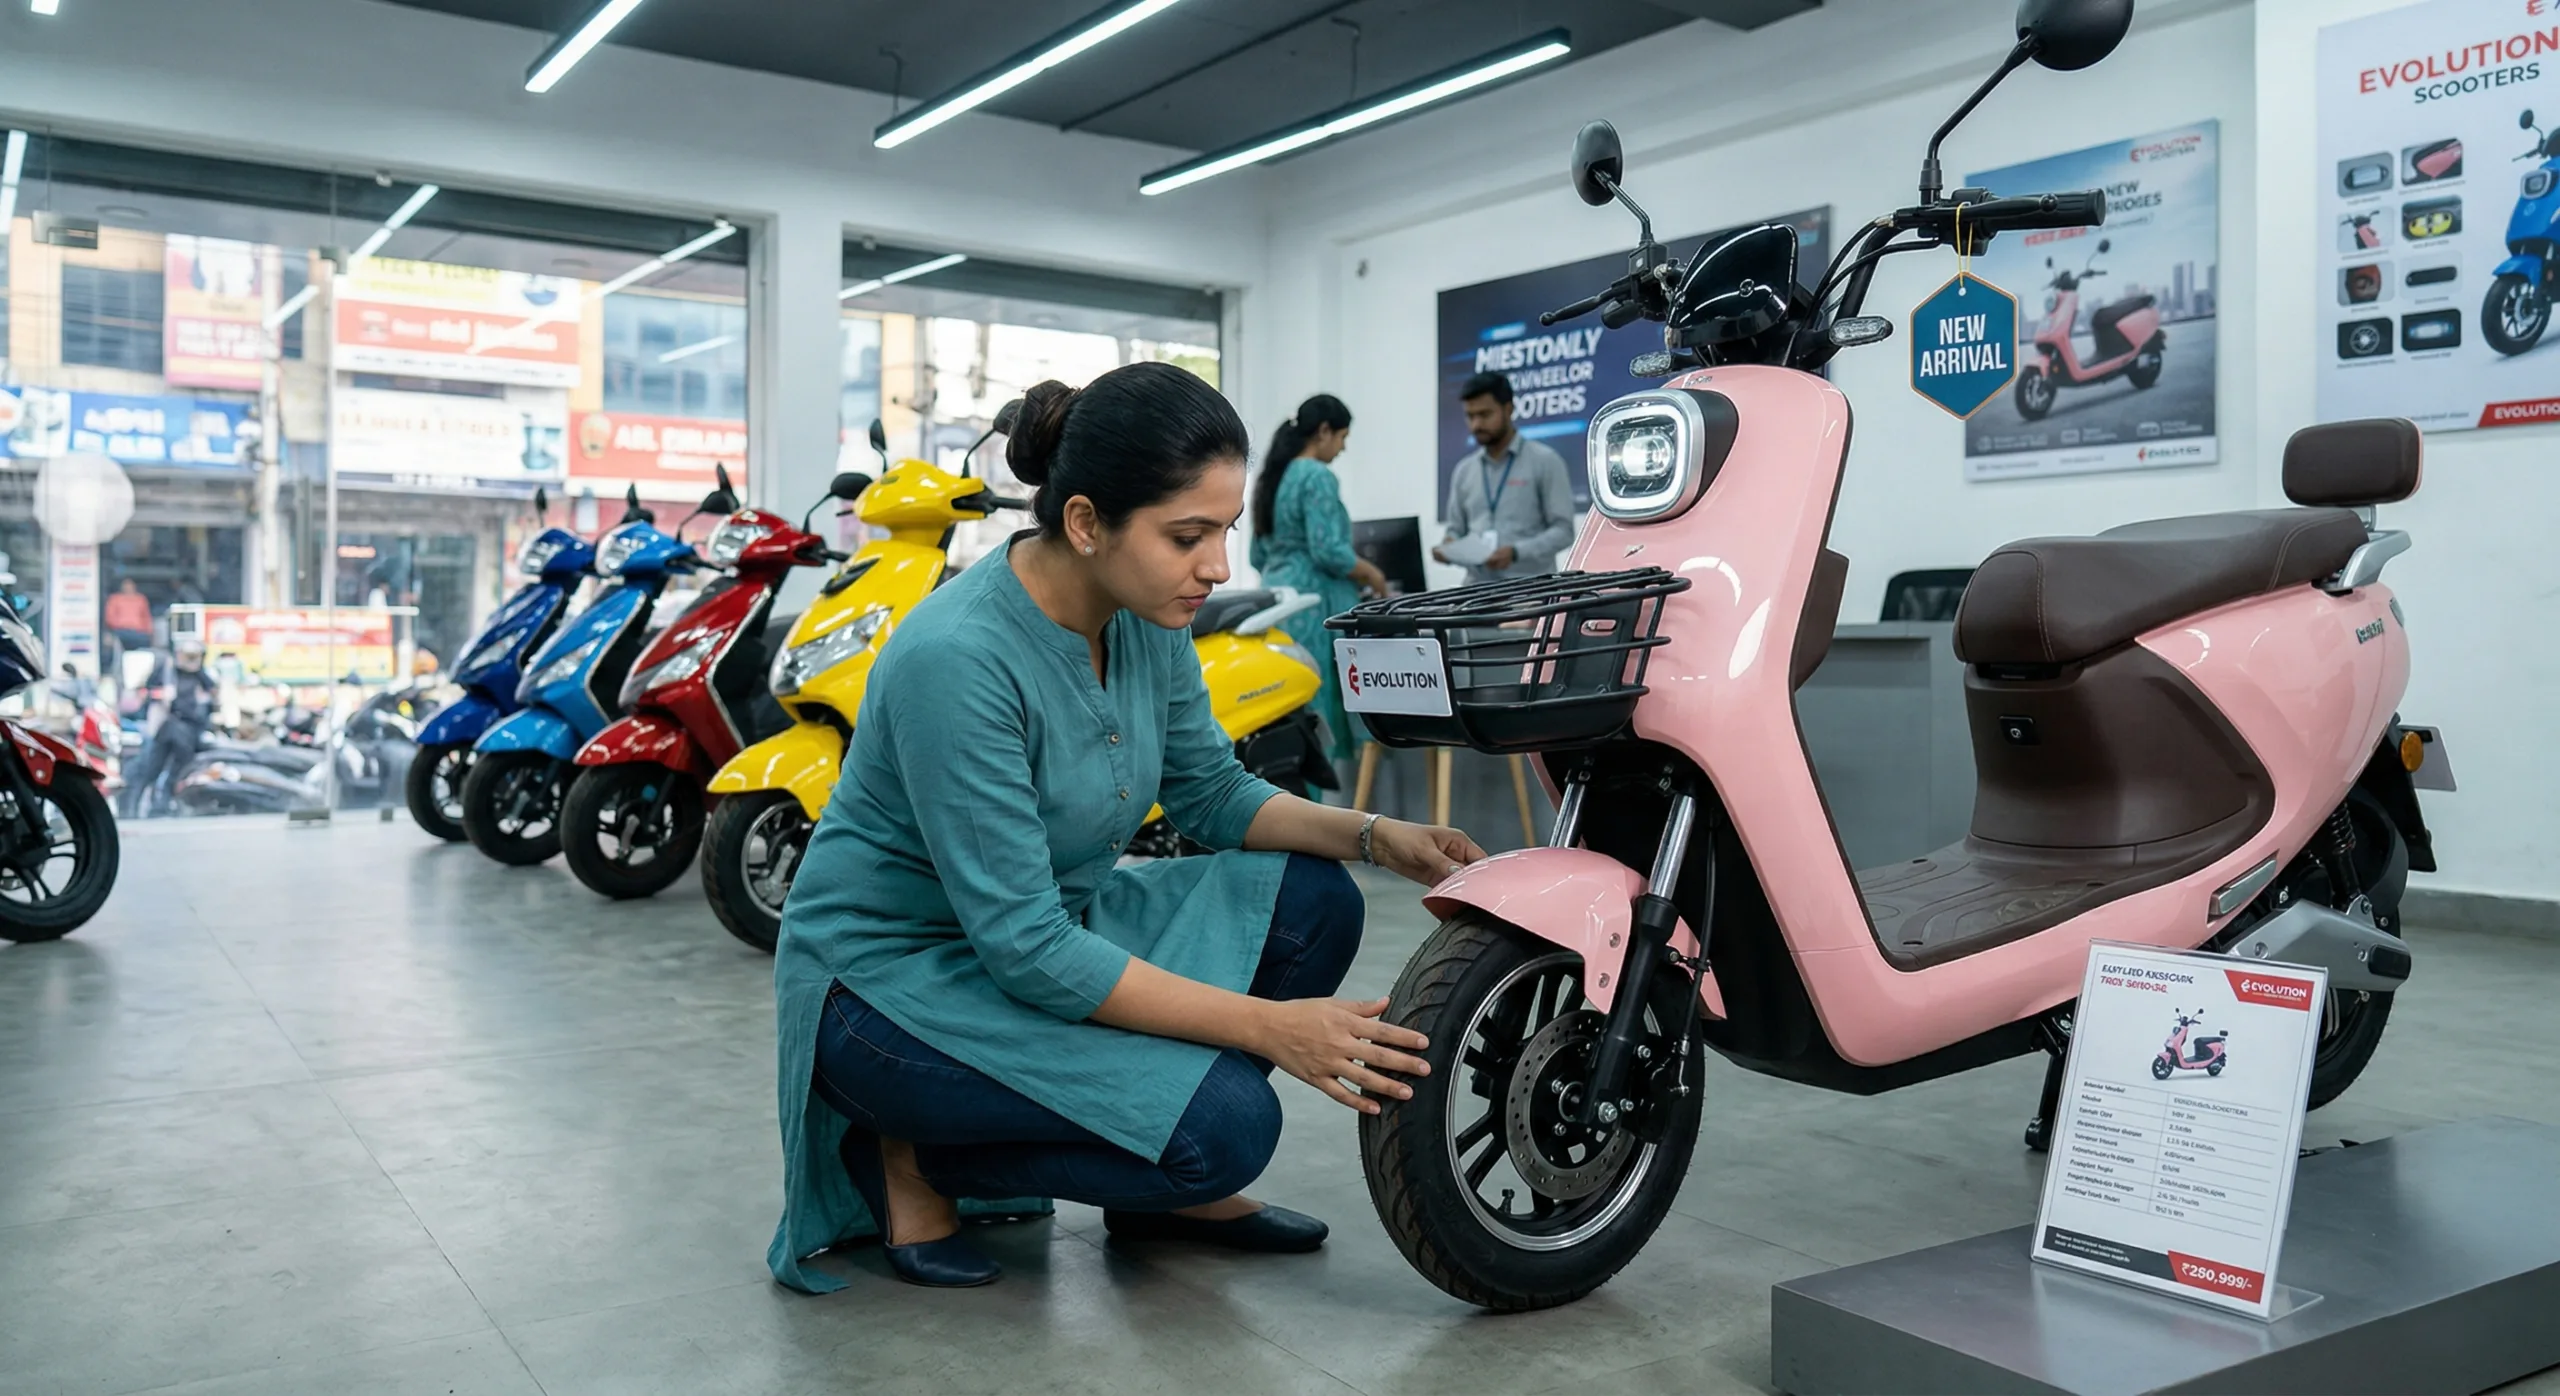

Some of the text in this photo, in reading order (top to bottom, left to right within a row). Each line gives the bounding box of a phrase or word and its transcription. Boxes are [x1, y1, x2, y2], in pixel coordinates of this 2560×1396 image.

[2360, 26, 2560, 94] EVOLUTION
[2414, 62, 2541, 104] SCOOTERS
[1939, 314, 1986, 345] NEW
[1920, 342, 2007, 377] ARRIVAL
[1362, 672, 1439, 689] EVOLUTION
